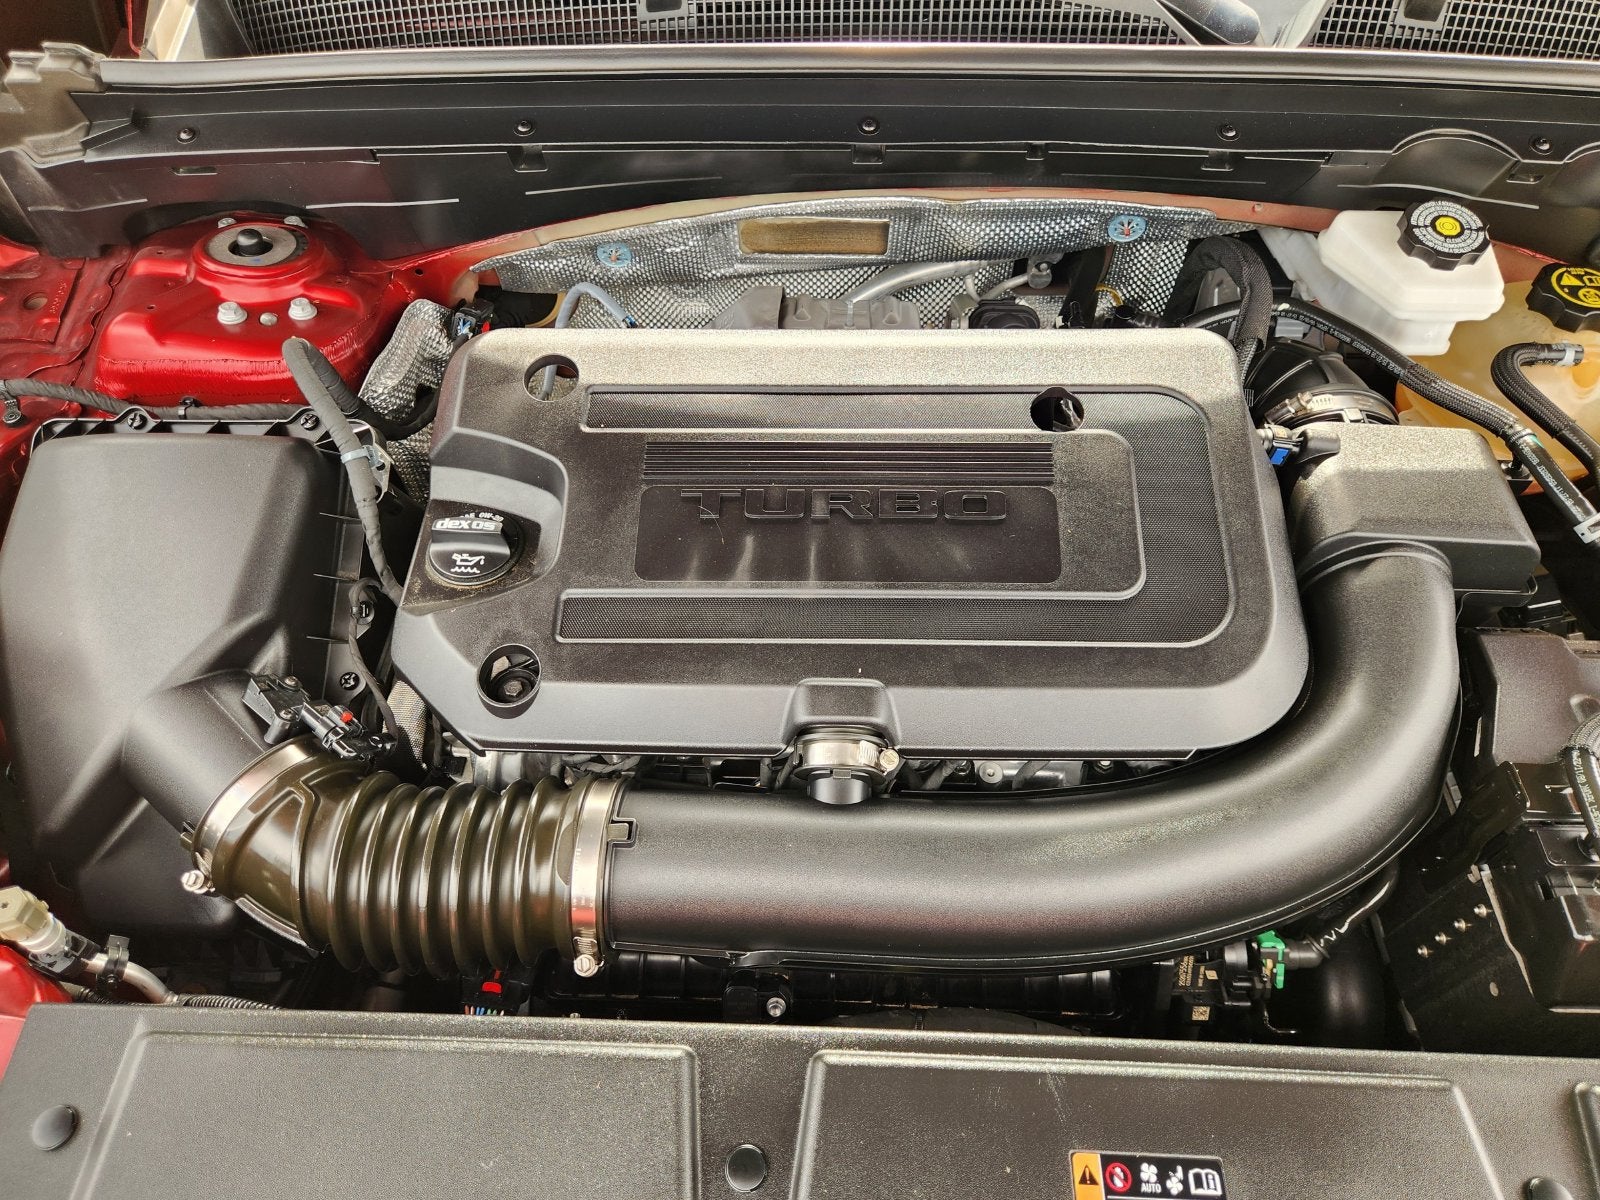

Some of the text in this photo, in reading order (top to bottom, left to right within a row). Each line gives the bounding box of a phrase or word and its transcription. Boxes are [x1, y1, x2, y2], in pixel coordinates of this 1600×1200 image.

[680, 488, 1007, 520] TURBO
[436, 518, 495, 530] dexos
[1140, 1182, 1161, 1194] AUTO
